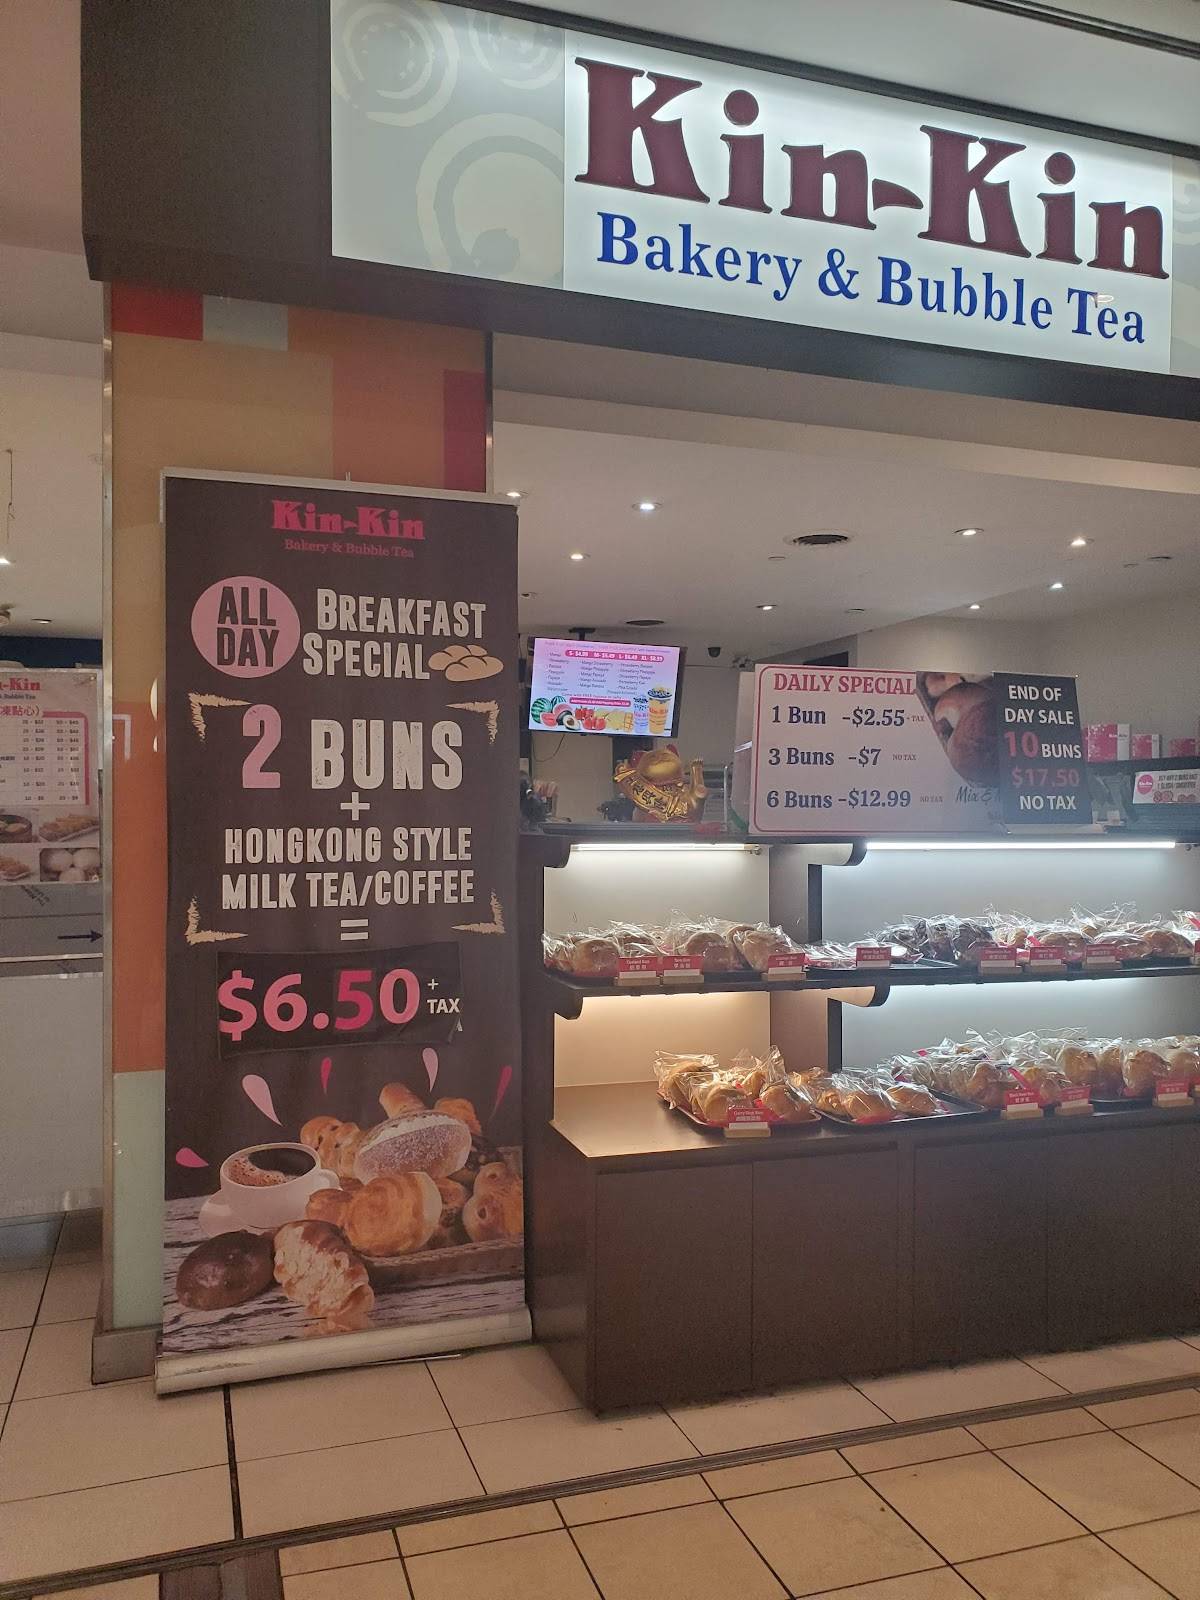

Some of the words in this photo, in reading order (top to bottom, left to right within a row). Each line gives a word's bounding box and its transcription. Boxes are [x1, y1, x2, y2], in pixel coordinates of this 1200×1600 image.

[574, 56, 1170, 280] Kin-Kin
[596, 211, 802, 302] Bakery
[817, 247, 859, 301] &
[877, 255, 1053, 331] Bubble
[1067, 287, 1145, 345] Tea
[272, 499, 426, 540] Kin-Kin
[284, 538, 329, 554] Bakery
[332, 543, 342, 553] &
[346, 542, 389, 557] Bubble
[391, 546, 415, 558] Tea
[217, 586, 277, 626] ALL
[316, 588, 486, 639] BREAKFAST
[216, 628, 280, 668] DAY
[302, 632, 431, 680] SPECIAL
[774, 673, 835, 692] DAILY
[838, 675, 917, 696] SPECIAL
[1008, 685, 1039, 701] END
[1042, 687, 1062, 701] OF
[772, 705, 781, 723] 1
[788, 706, 826, 725] Bun
[1004, 707, 1035, 723] DAY
[1038, 709, 1075, 725] SALE
[242, 704, 282, 789] 2
[311, 718, 463, 790] BUNS
[768, 748, 781, 766] 3
[786, 747, 835, 766] Buns
[1003, 731, 1039, 758] 10
[1041, 743, 1082, 759] BUNS
[1011, 765, 1080, 788] $17.50
[766, 790, 779, 808] 6
[784, 790, 833, 808] Buns
[1019, 795, 1044, 810] NO
[1046, 795, 1077, 810] TAX
[224, 827, 382, 864] HONGKONG
[393, 827, 472, 861] STYLE
[222, 872, 297, 910] MILK
[305, 870, 475, 908] TEA/COFFEE
[217, 968, 421, 1042] $6.50
[426, 998, 460, 1014] TAX
